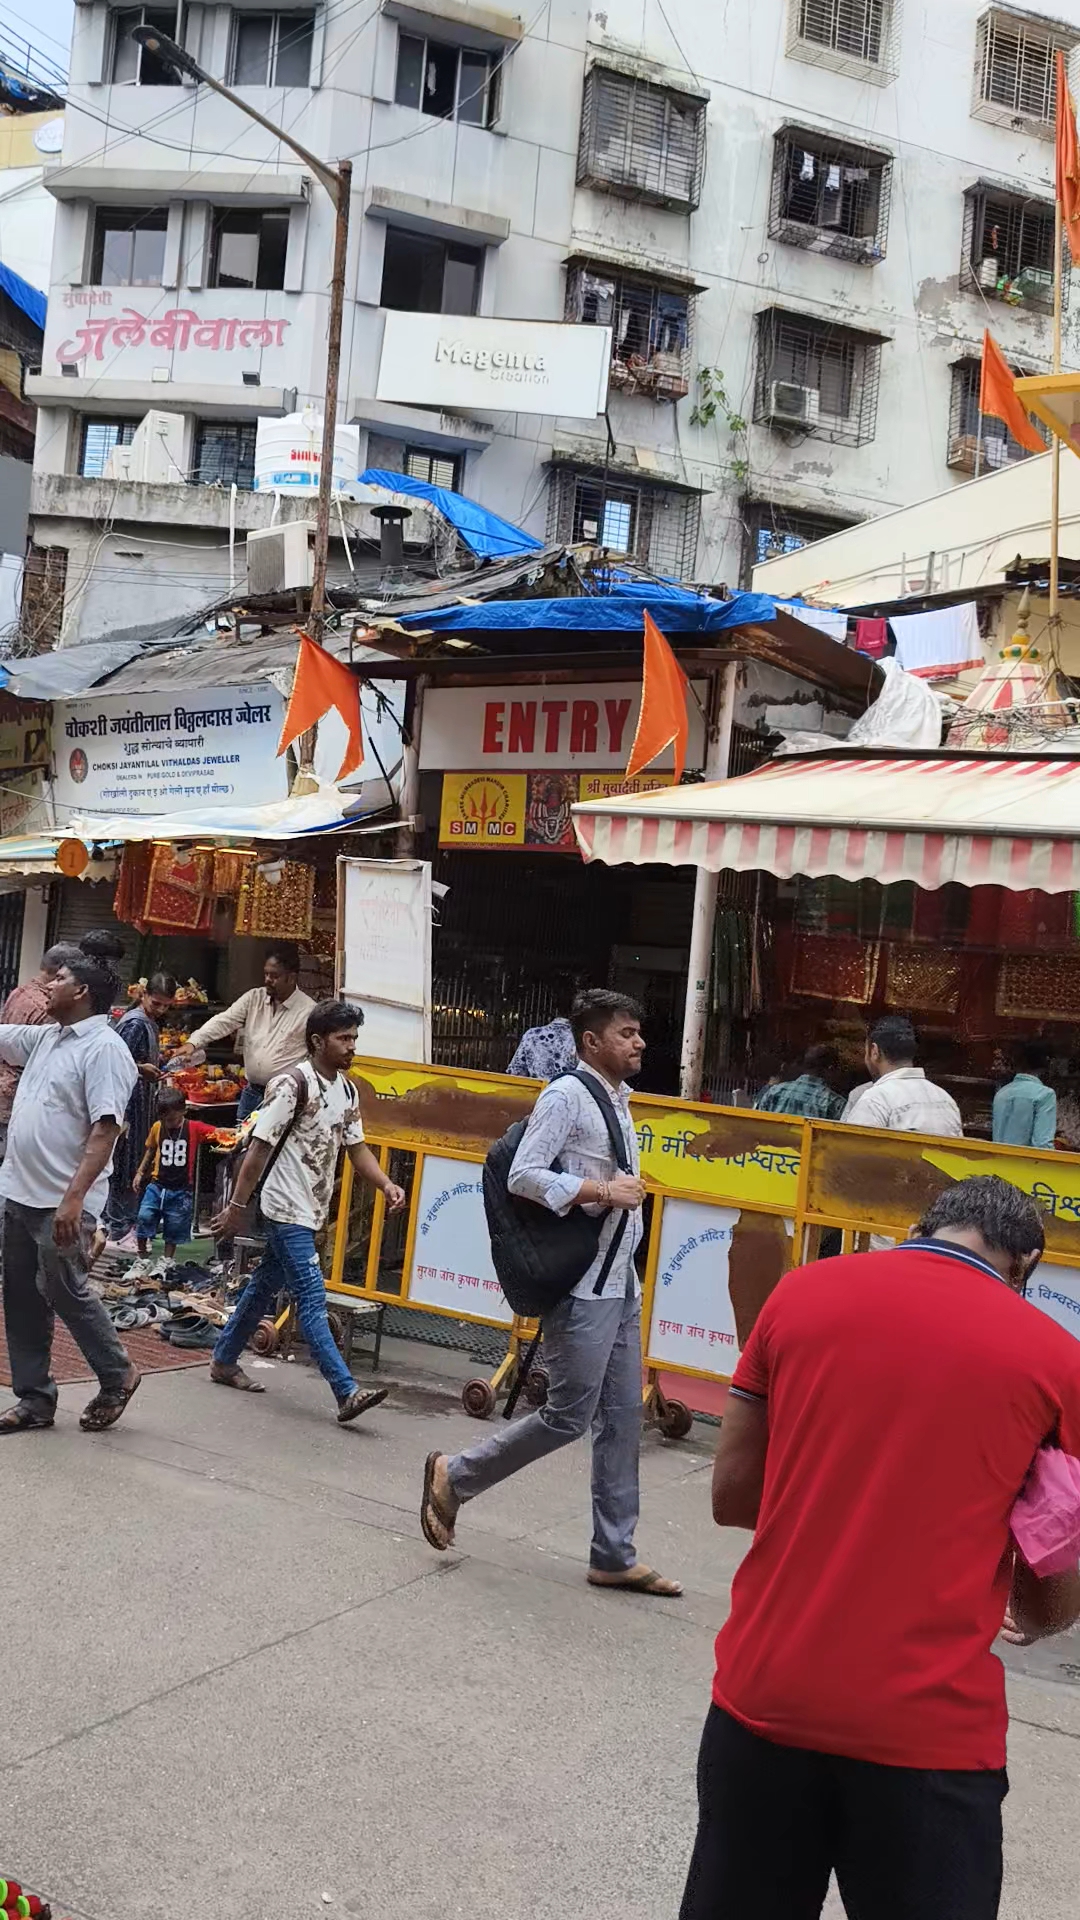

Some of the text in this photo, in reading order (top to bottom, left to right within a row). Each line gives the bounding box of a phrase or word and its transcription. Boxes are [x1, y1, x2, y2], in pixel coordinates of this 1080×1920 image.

[56, 308, 290, 363] जलेबीवाला
[435, 337, 547, 371] Magenta
[65, 714, 107, 738] चोकशी
[110, 709, 171, 734] जयंतीलाल
[235, 702, 271, 724] ज्वेलर
[482, 699, 632, 753] ENTRY
[124, 735, 204, 756] शुद्ध सोन्याचे व्यापारी
[92, 754, 240, 771] CHOKSI JAYANTILAL VITHALDAS JEWELLER
[161, 771, 175, 779] GOLD
[587, 779, 600, 794] श्री
[161, 1139, 187, 1167] 98
[426, 1190, 450, 1222] मुंबादेवी
[451, 1182, 474, 1196] मंदिर
[662, 1272, 673, 1287] श्री
[668, 1236, 698, 1271] मुंबादेवी
[699, 1228, 727, 1243] मंदिर
[417, 1265, 437, 1280] सुरक्षा
[440, 1267, 455, 1282] जांच
[458, 1273, 480, 1289] कृपया
[658, 1319, 735, 1347] सुरक्षा जांच कृपया
